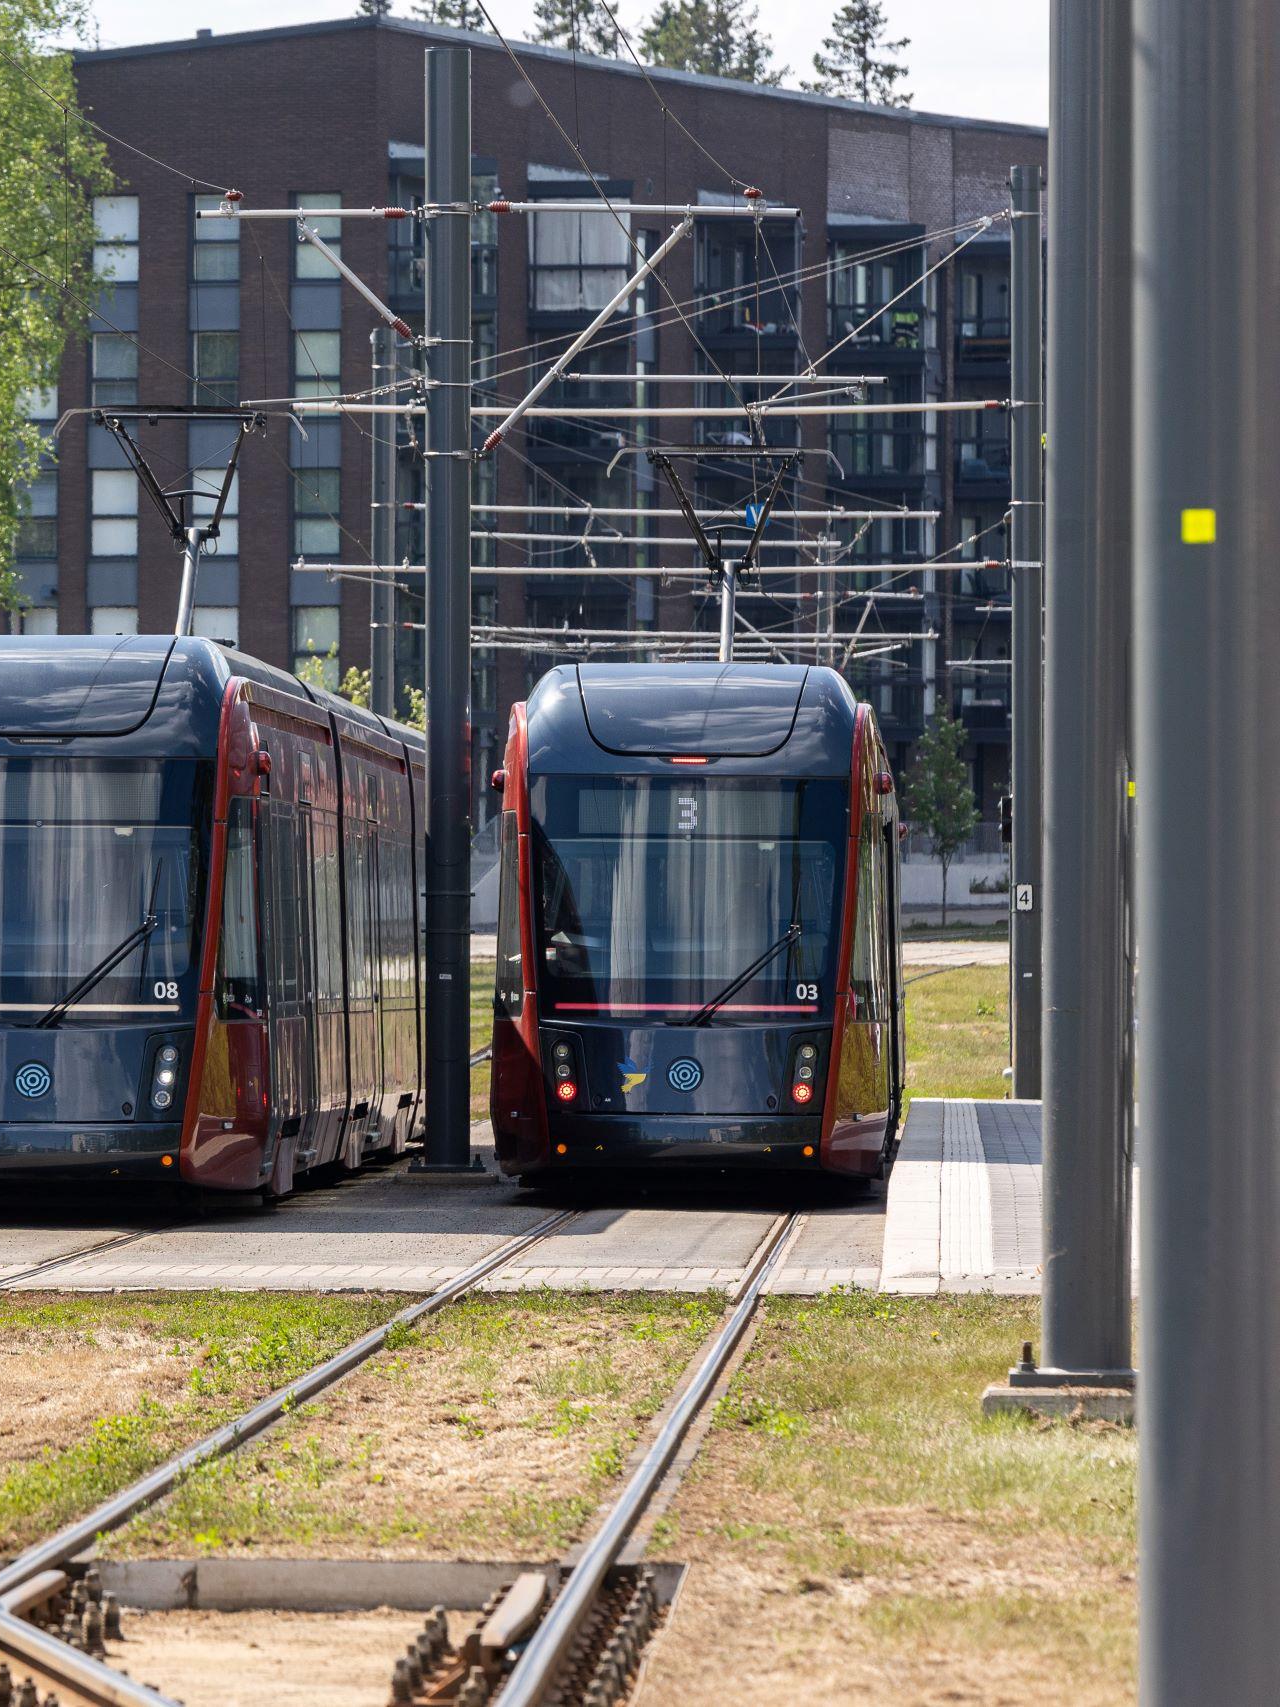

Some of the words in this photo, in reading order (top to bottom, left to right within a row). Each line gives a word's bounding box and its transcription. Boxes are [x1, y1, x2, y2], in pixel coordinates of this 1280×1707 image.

[678, 797, 698, 830] 3
[1019, 890, 1030, 905] 4
[154, 981, 179, 999] 08
[796, 983, 818, 1000] 03
